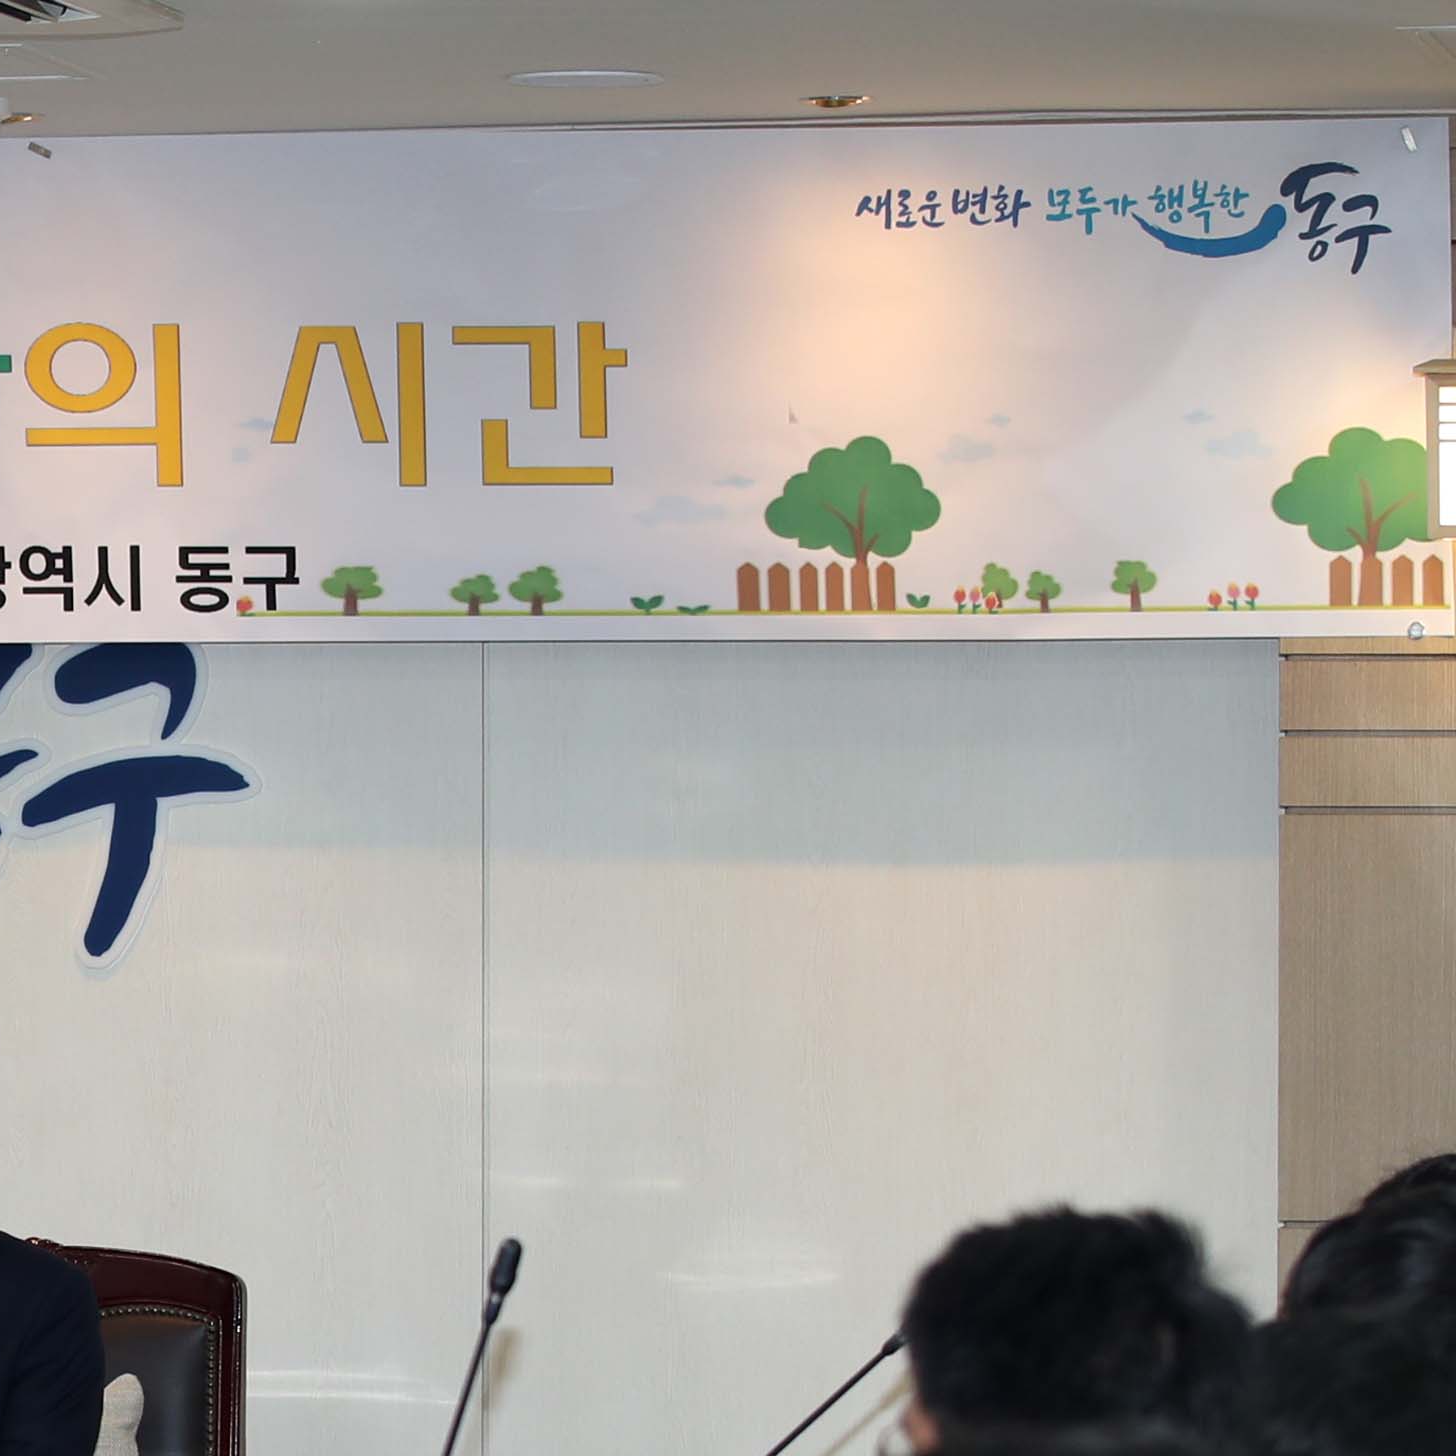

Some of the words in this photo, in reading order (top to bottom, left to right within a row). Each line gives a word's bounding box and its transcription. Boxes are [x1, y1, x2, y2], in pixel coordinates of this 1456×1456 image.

[855, 188, 945, 230] 새로운
[951, 184, 1032, 228] 변화
[1046, 185, 1138, 236] 모두가
[1148, 180, 1251, 233] 행복한
[1280, 161, 1393, 275] 동구
[270, 321, 628, 487] 시간
[174, 545, 301, 614] 동구
